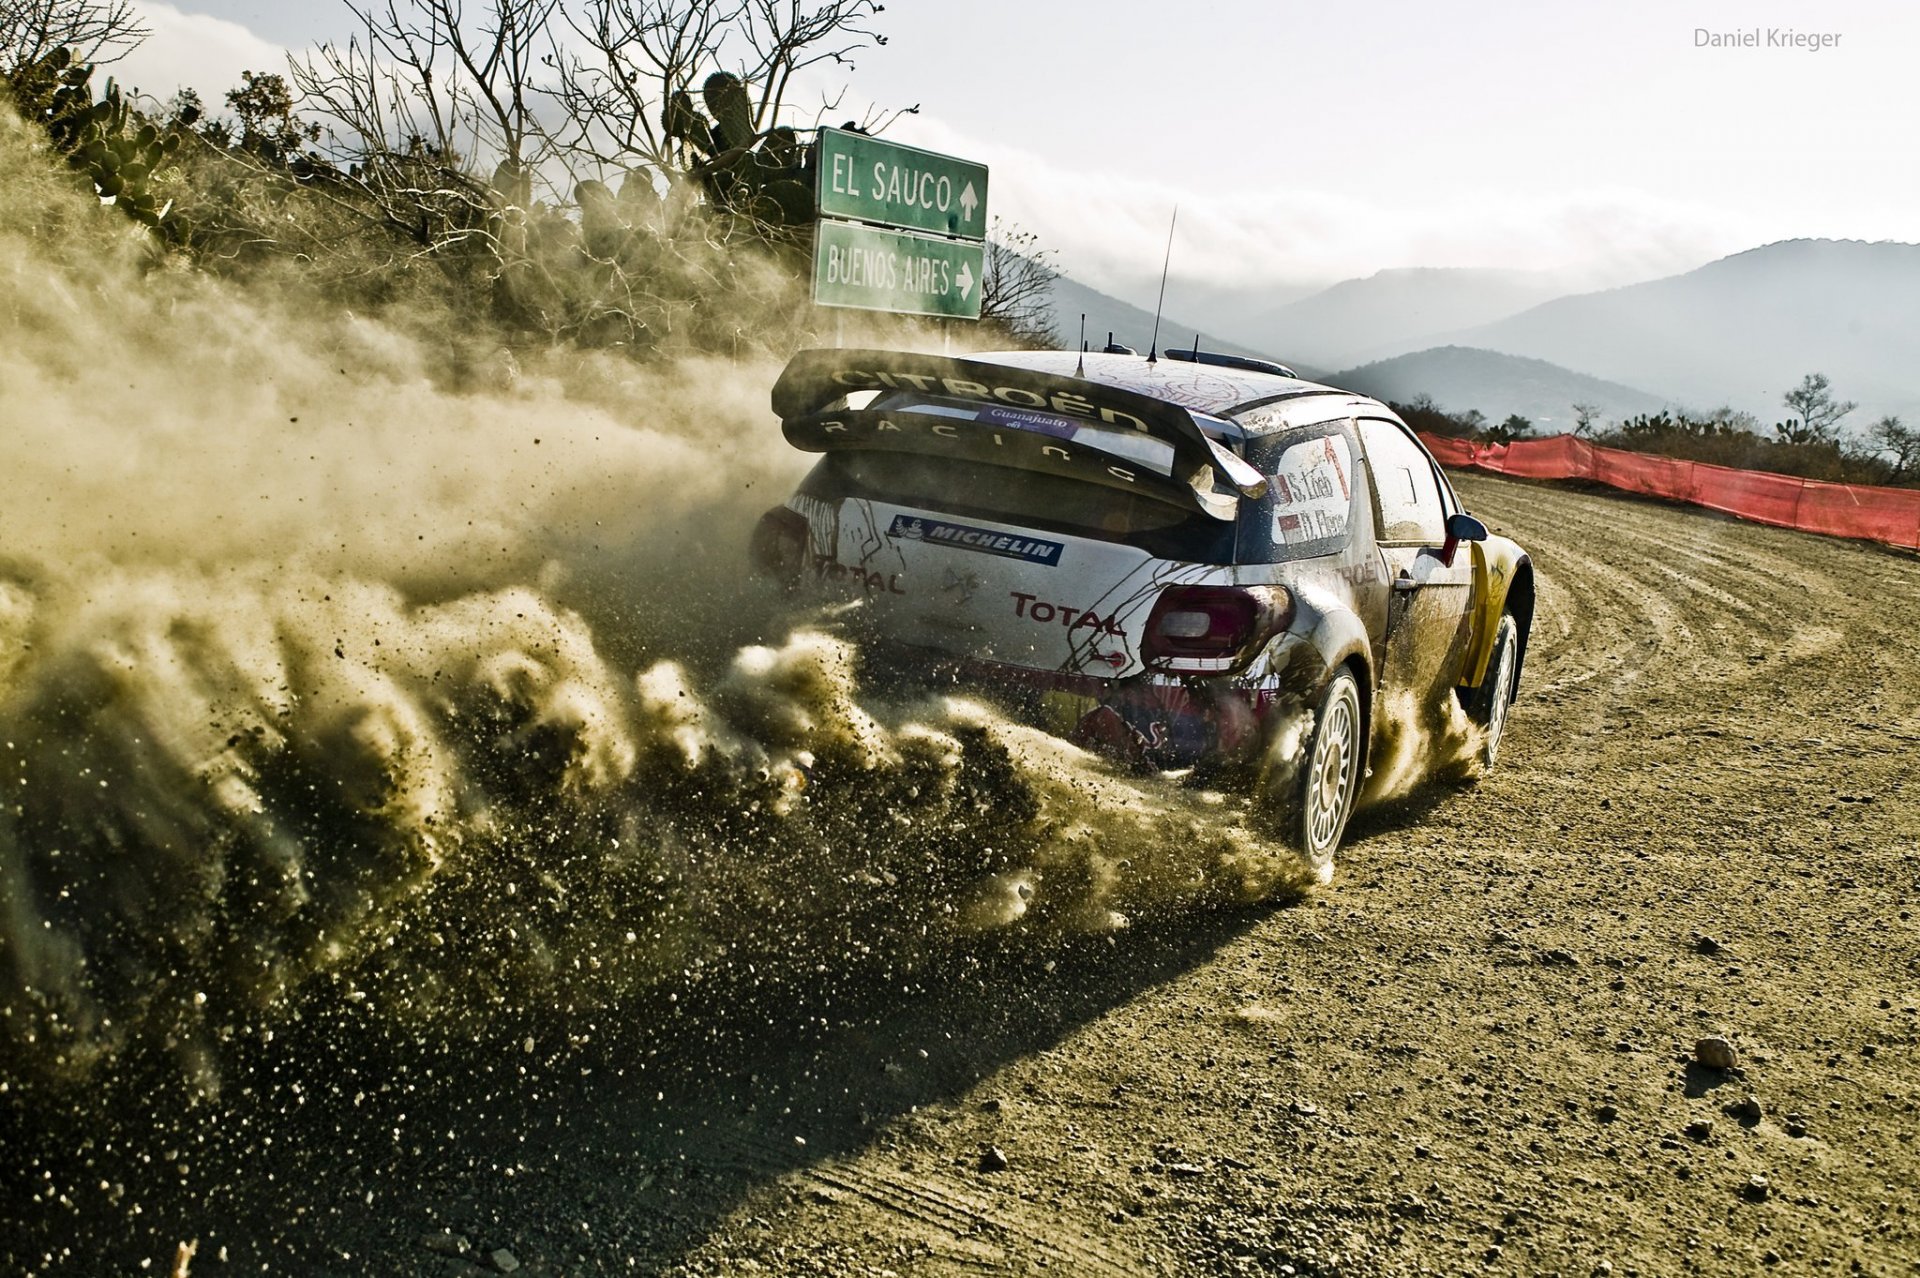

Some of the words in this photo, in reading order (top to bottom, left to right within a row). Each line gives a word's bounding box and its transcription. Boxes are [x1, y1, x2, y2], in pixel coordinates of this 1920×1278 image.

[832, 153, 860, 197] EL
[872, 162, 951, 212] SAUCO
[827, 245, 896, 289] BUENOS
[904, 256, 949, 295] AIRES
[991, 408, 1068, 428] Guanajuato
[821, 420, 1136, 482] RACING
[930, 526, 1055, 558] MICHELIN
[1010, 591, 1127, 637] TOTAL
